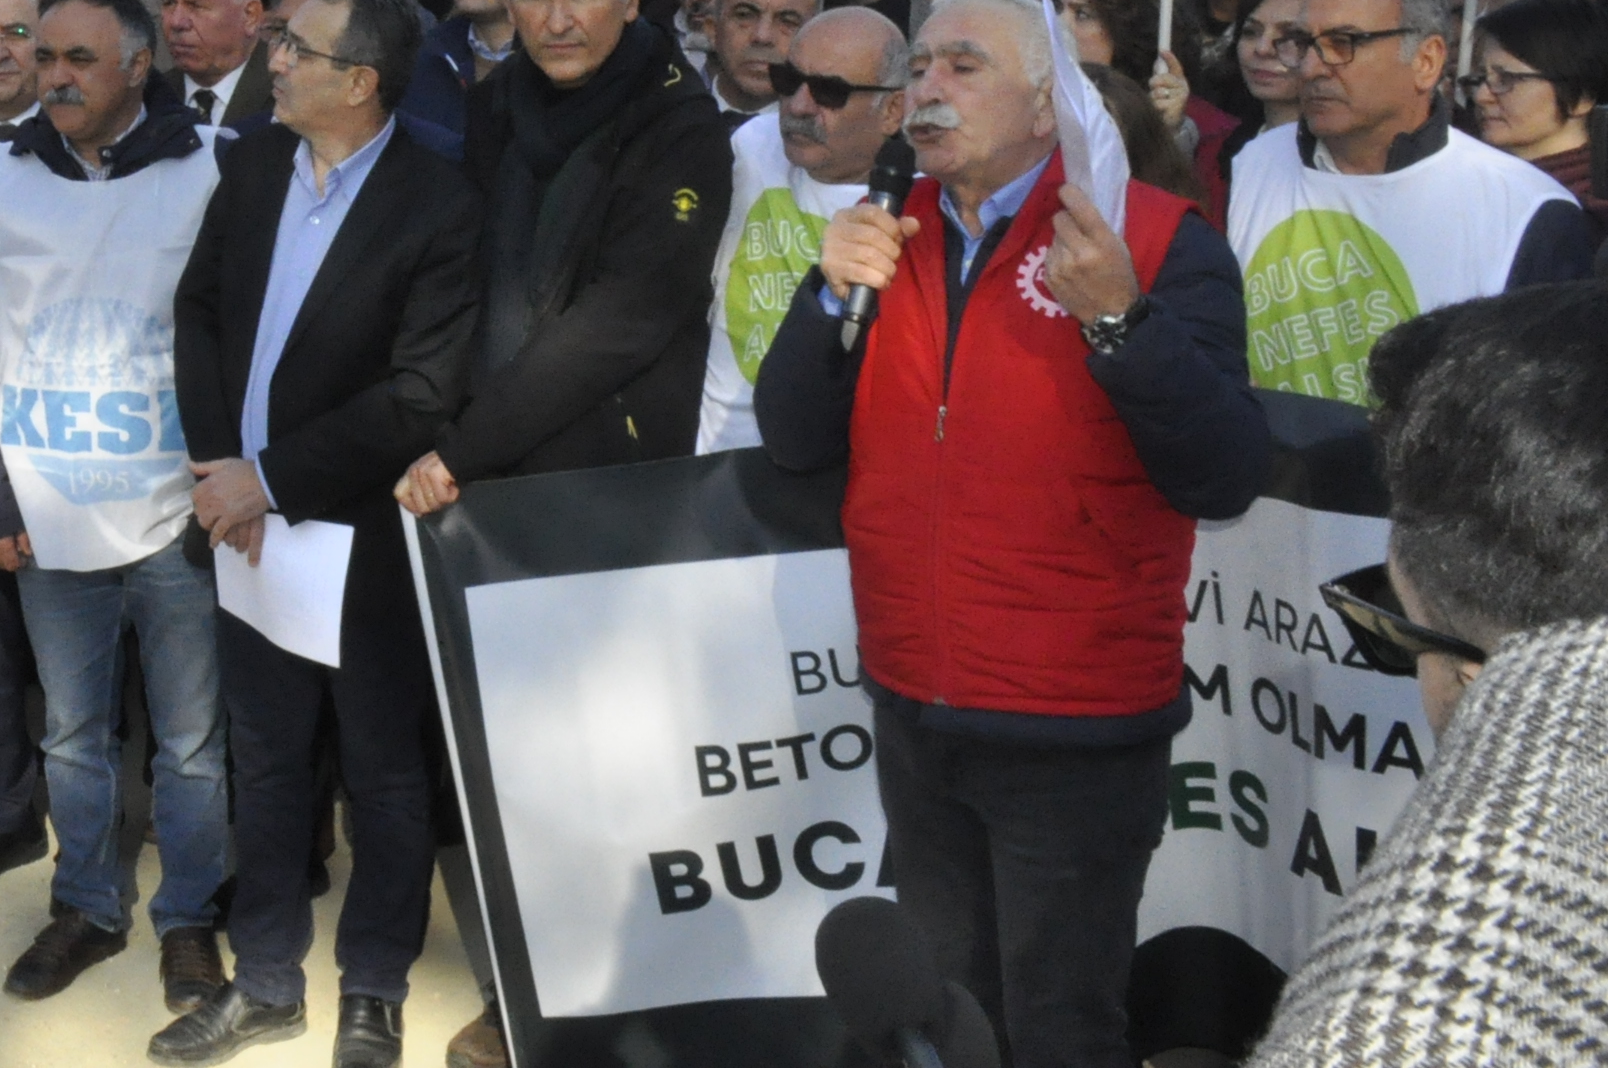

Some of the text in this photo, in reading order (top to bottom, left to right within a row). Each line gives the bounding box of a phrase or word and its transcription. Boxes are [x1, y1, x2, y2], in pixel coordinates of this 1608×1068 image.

[1247, 240, 1372, 316] BUCA
[1253, 290, 1399, 371] NEFES
[68, 468, 130, 495] 1995
[648, 820, 895, 915] BUC
